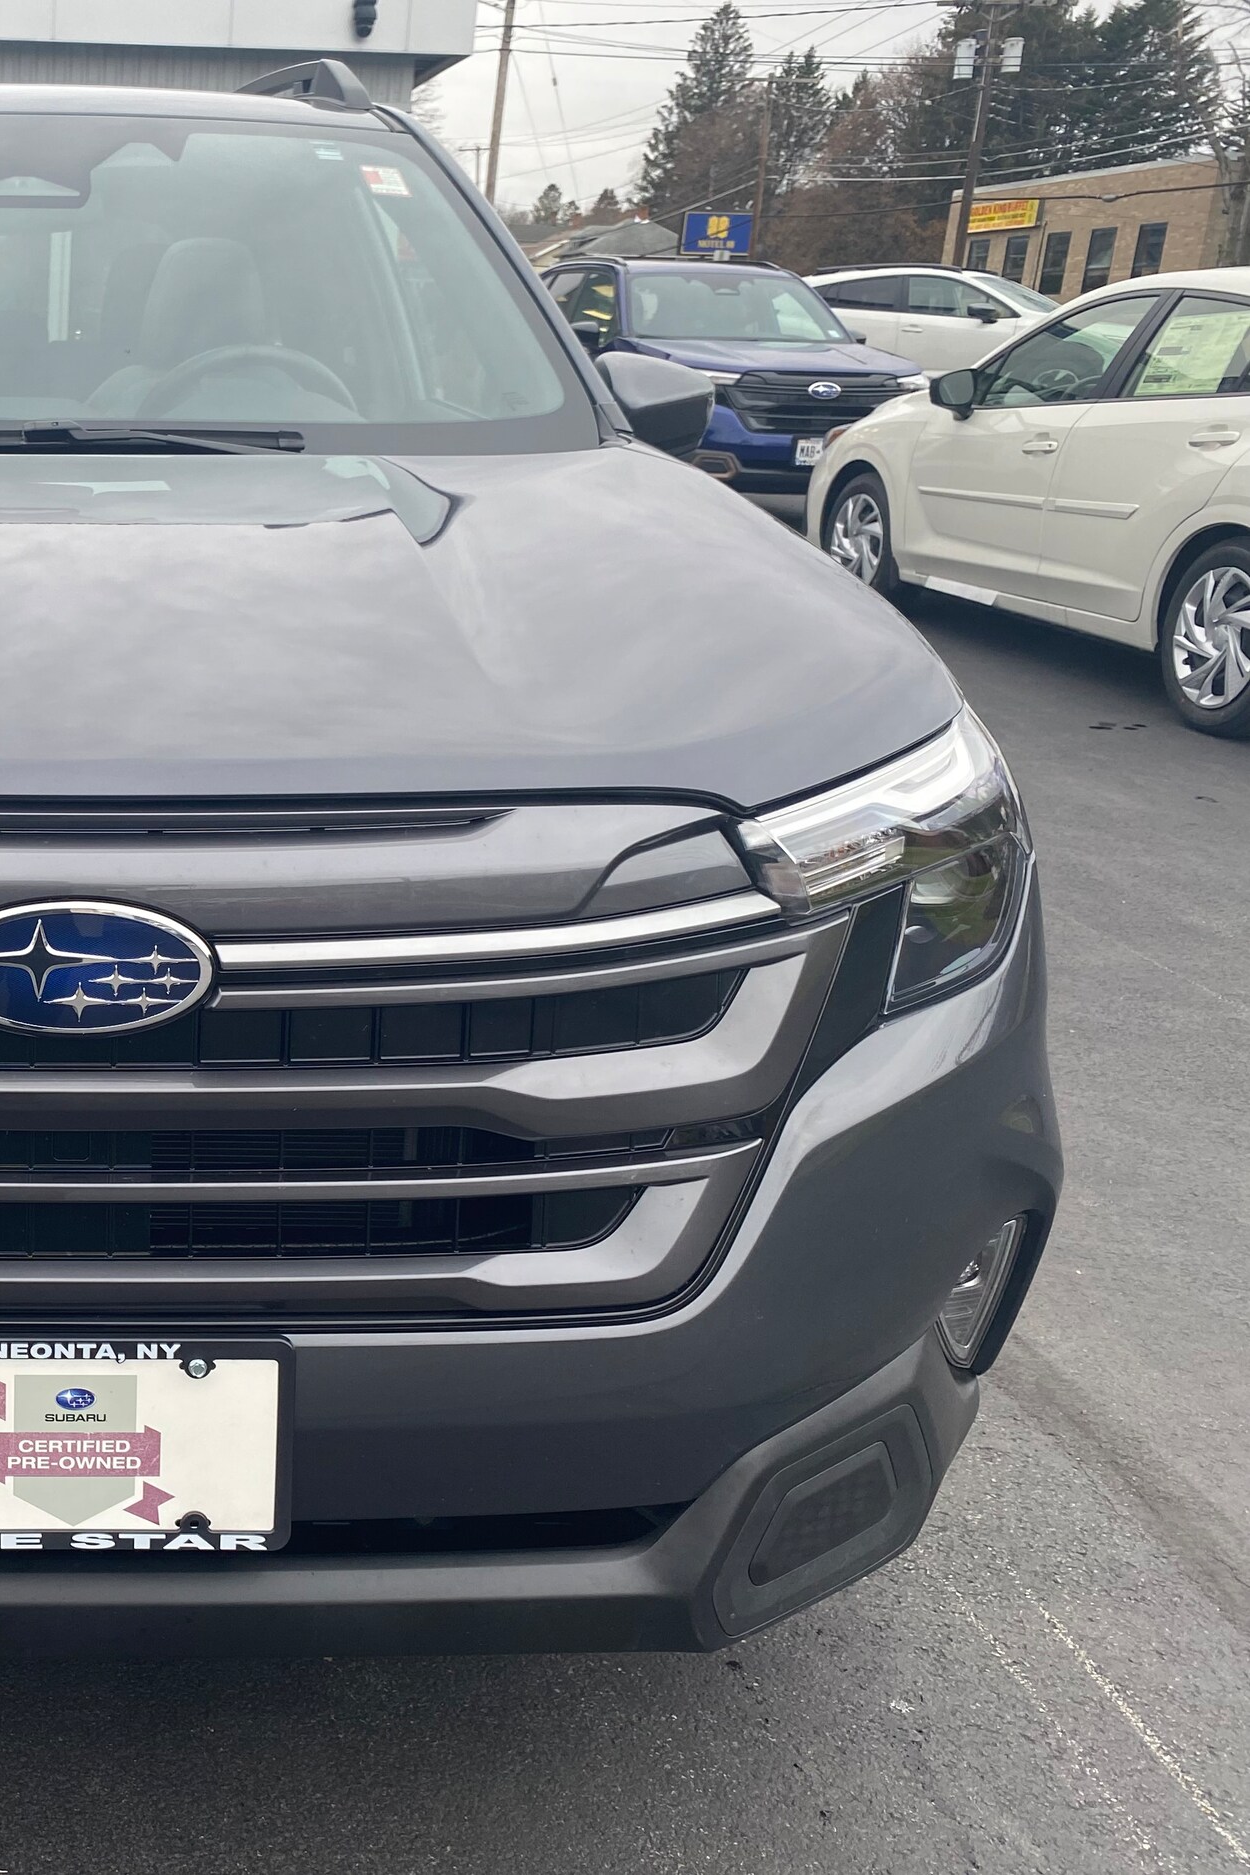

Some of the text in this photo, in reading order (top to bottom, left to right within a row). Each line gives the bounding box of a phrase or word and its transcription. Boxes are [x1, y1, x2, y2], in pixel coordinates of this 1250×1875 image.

[137, 1343, 181, 1360] NY
[44, 1413, 107, 1423] SUBARU
[18, 1440, 131, 1454] CERTIFIED
[7, 1456, 142, 1471] PRE-OWNED
[70, 1533, 269, 1551] STAR
